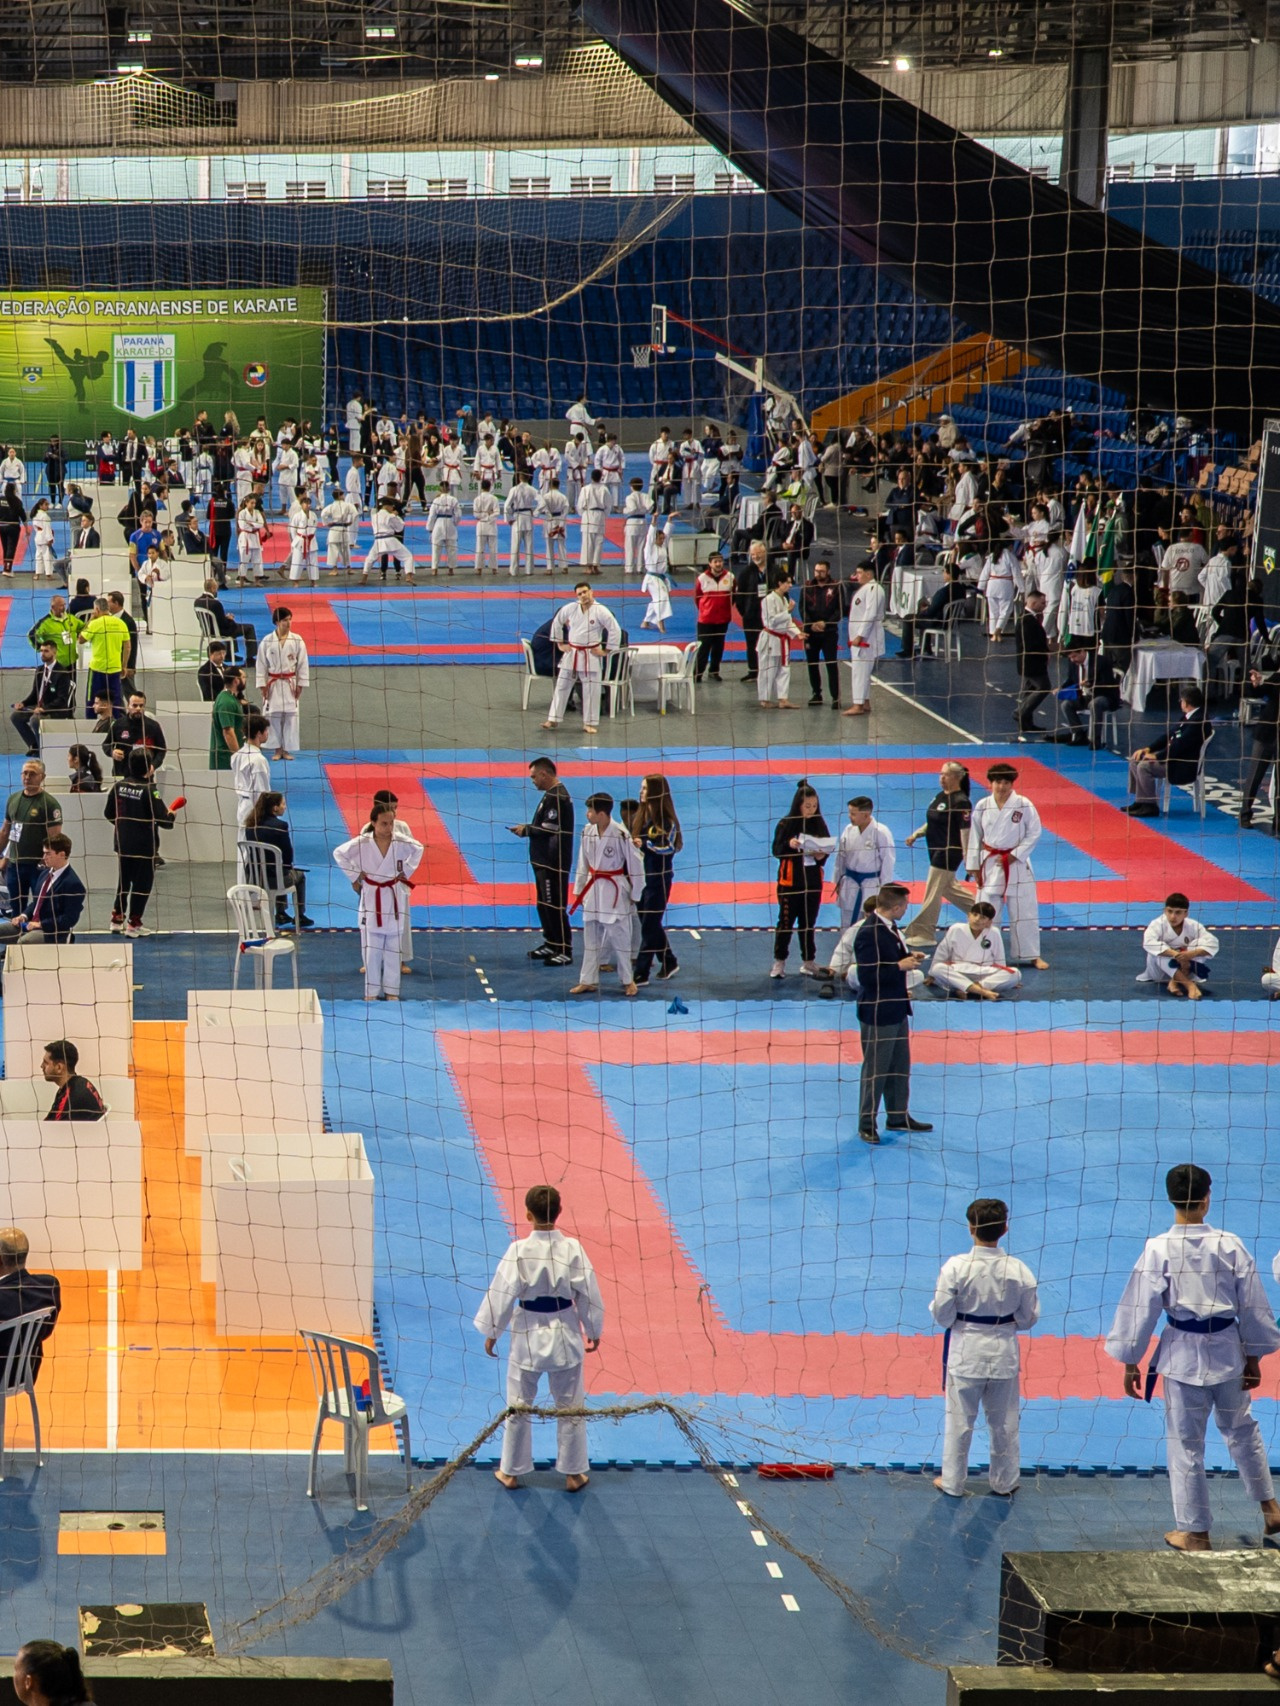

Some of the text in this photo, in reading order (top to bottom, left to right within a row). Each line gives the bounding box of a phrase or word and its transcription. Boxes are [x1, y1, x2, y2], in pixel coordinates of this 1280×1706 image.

[94, 299, 203, 316] PARANAENSE
[207, 299, 229, 315] DE
[233, 297, 298, 314] KARATE
[123, 335, 165, 346] PARANÁ
[115, 345, 173, 356] KARATÊ-DO
